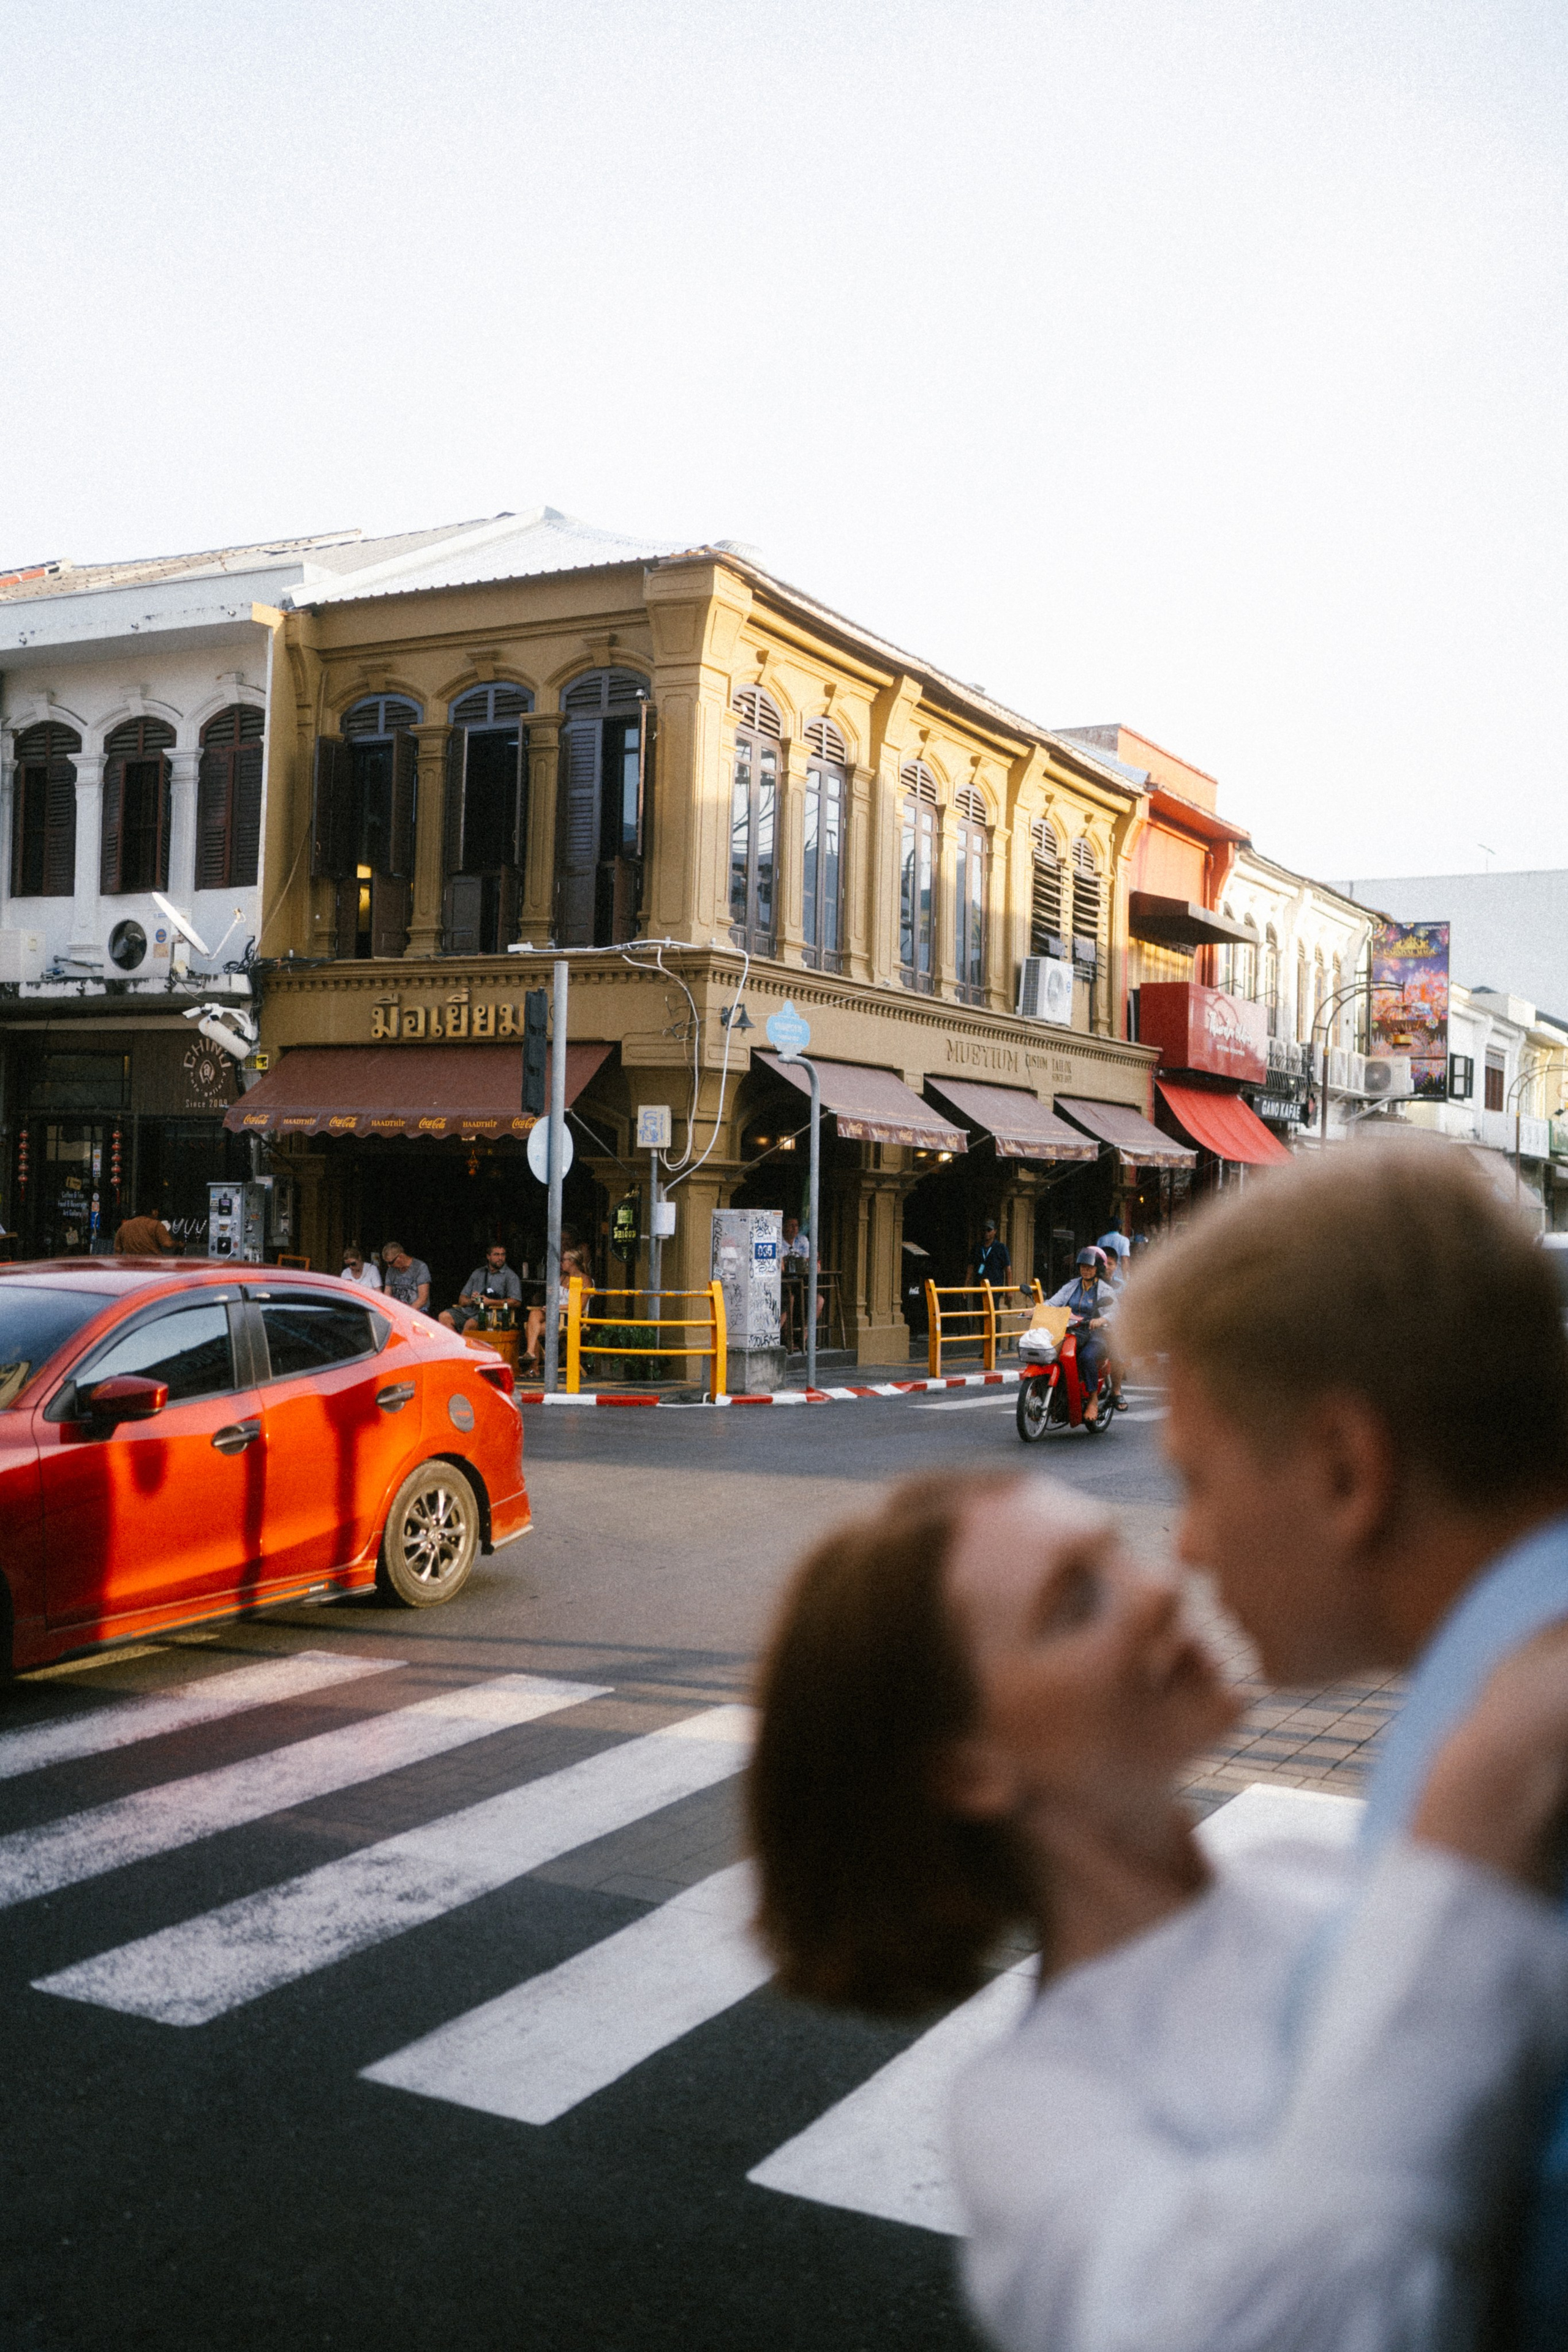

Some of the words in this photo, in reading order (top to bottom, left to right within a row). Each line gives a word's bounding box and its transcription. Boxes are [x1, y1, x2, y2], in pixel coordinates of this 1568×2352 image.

[186, 1099, 206, 1108] Since
[1262, 1100, 1280, 1117] GANO
[1280, 1102, 1301, 1120] KAFAE
